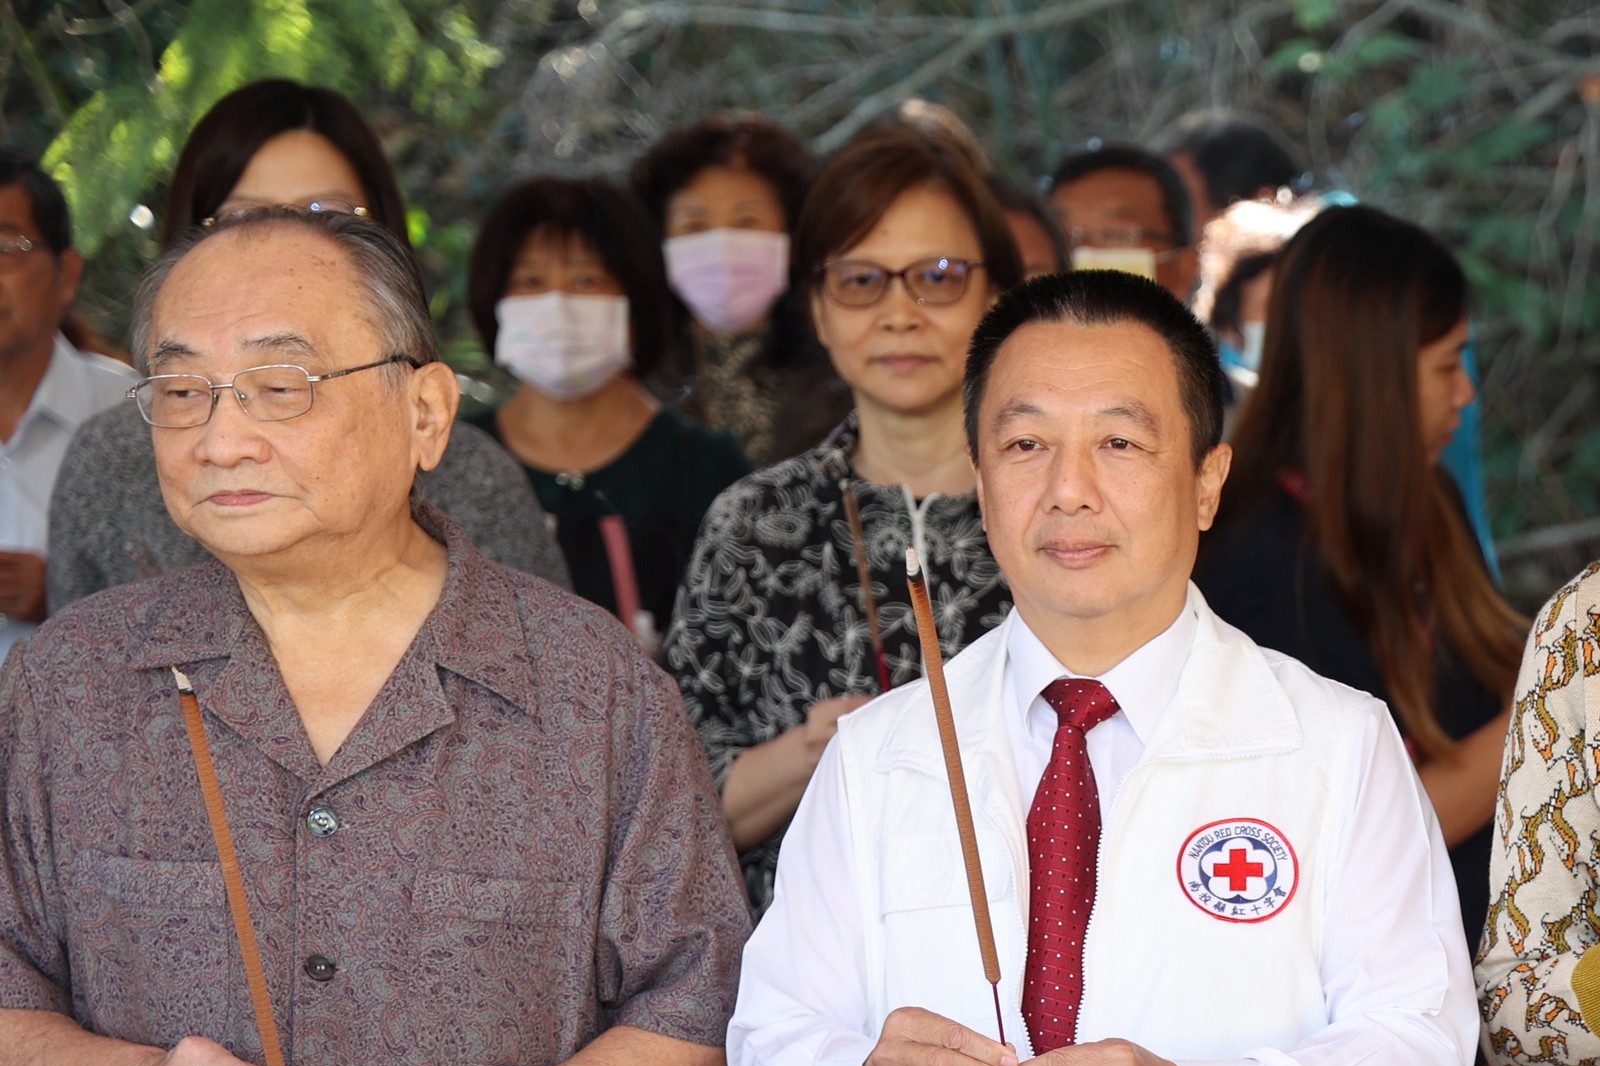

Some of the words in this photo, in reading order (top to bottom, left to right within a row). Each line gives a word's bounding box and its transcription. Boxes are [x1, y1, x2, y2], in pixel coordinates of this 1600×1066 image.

[1188, 833, 1214, 860] NANTOU
[1213, 827, 1232, 840] RED
[1234, 826, 1262, 838] CROSS
[1261, 832, 1288, 861] SOCIETY
[1188, 880, 1287, 916] 南投縣紅十字會
